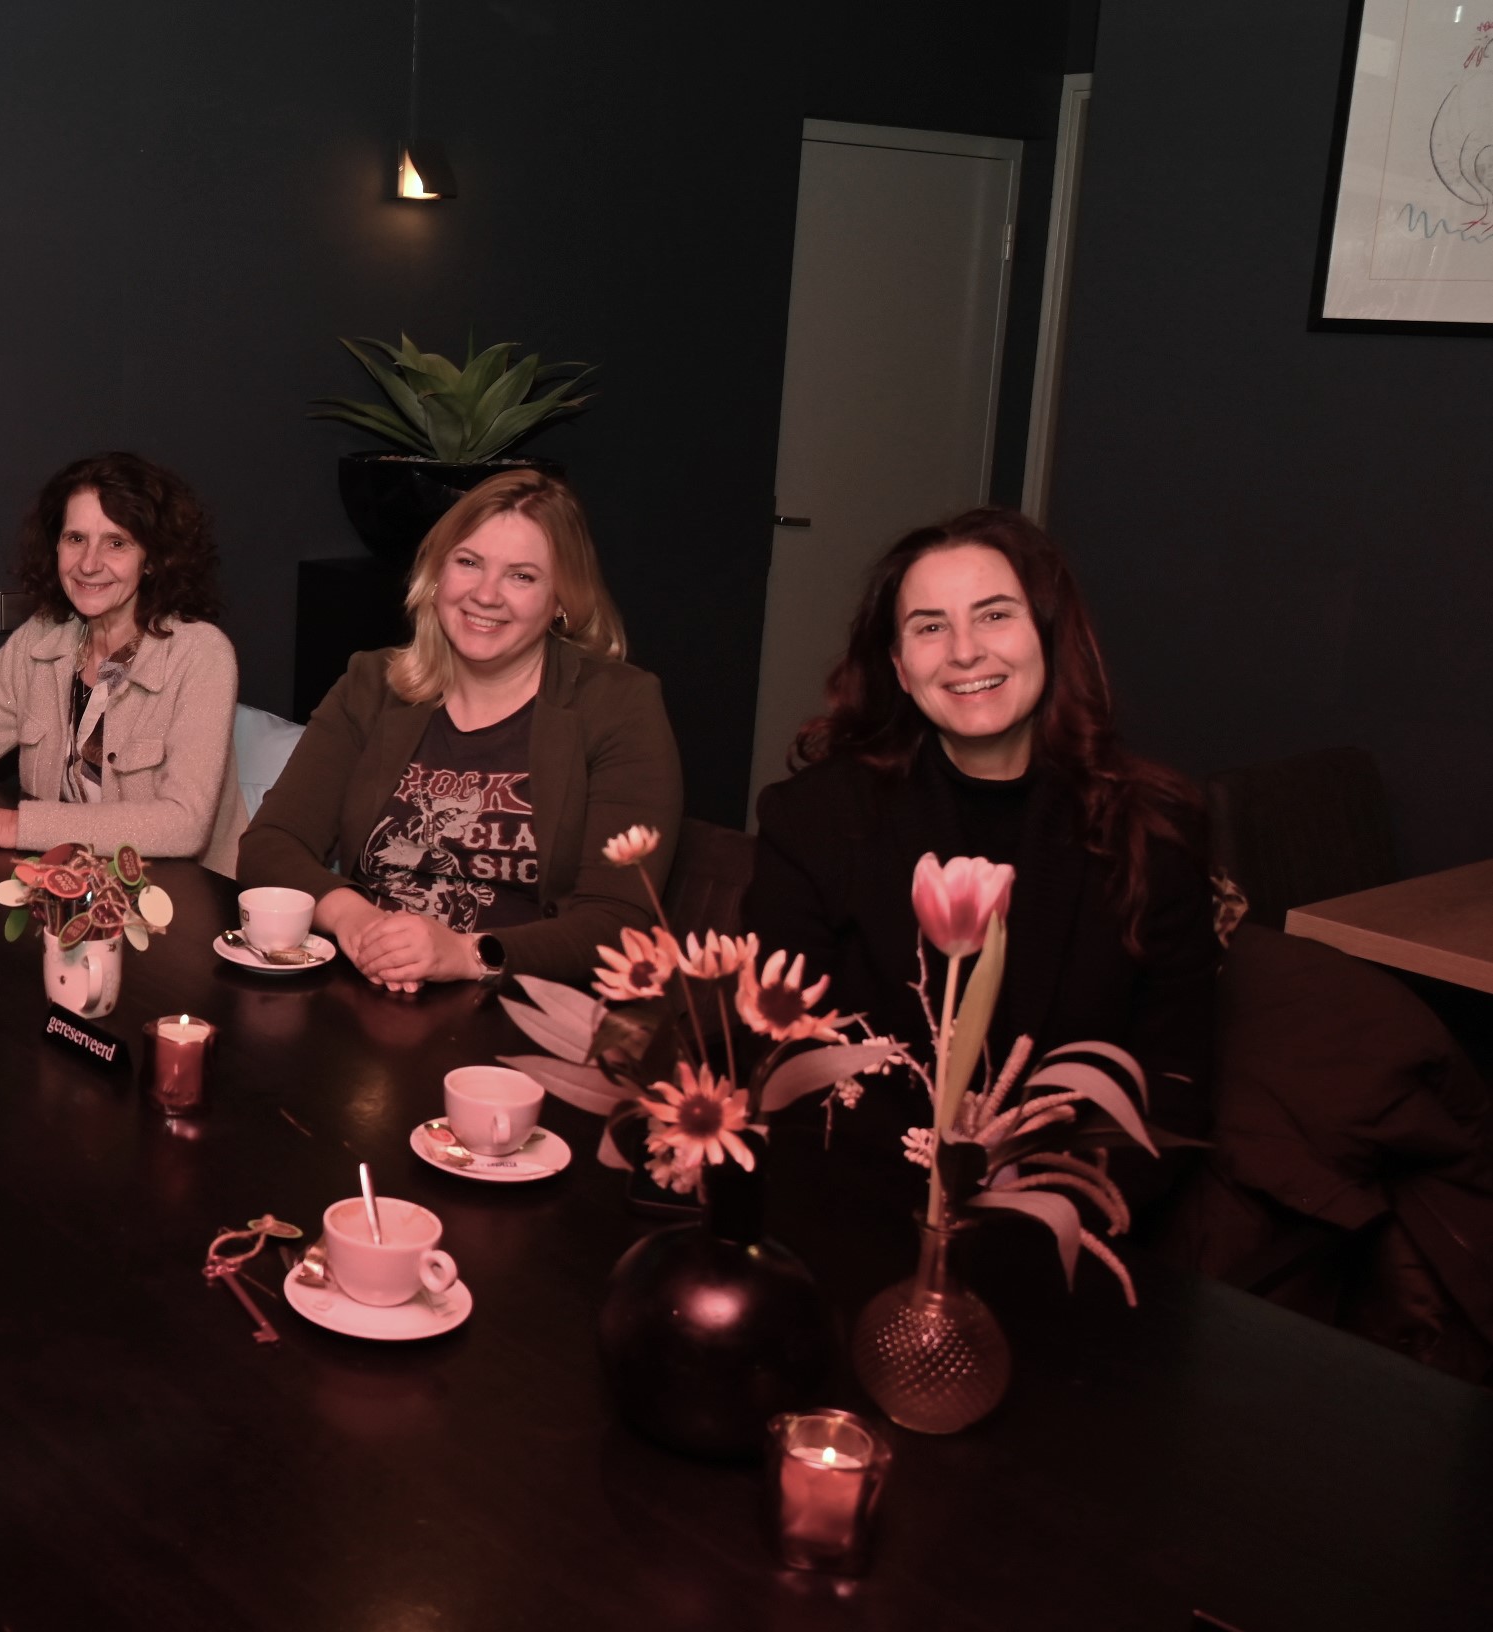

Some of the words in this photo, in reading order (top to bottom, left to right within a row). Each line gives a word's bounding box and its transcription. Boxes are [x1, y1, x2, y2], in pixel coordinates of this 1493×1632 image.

[393, 763, 533, 816] ROCK
[461, 822, 537, 851] CLA
[471, 854, 539, 884] SIC
[46, 1016, 117, 1062] gereserveerd
